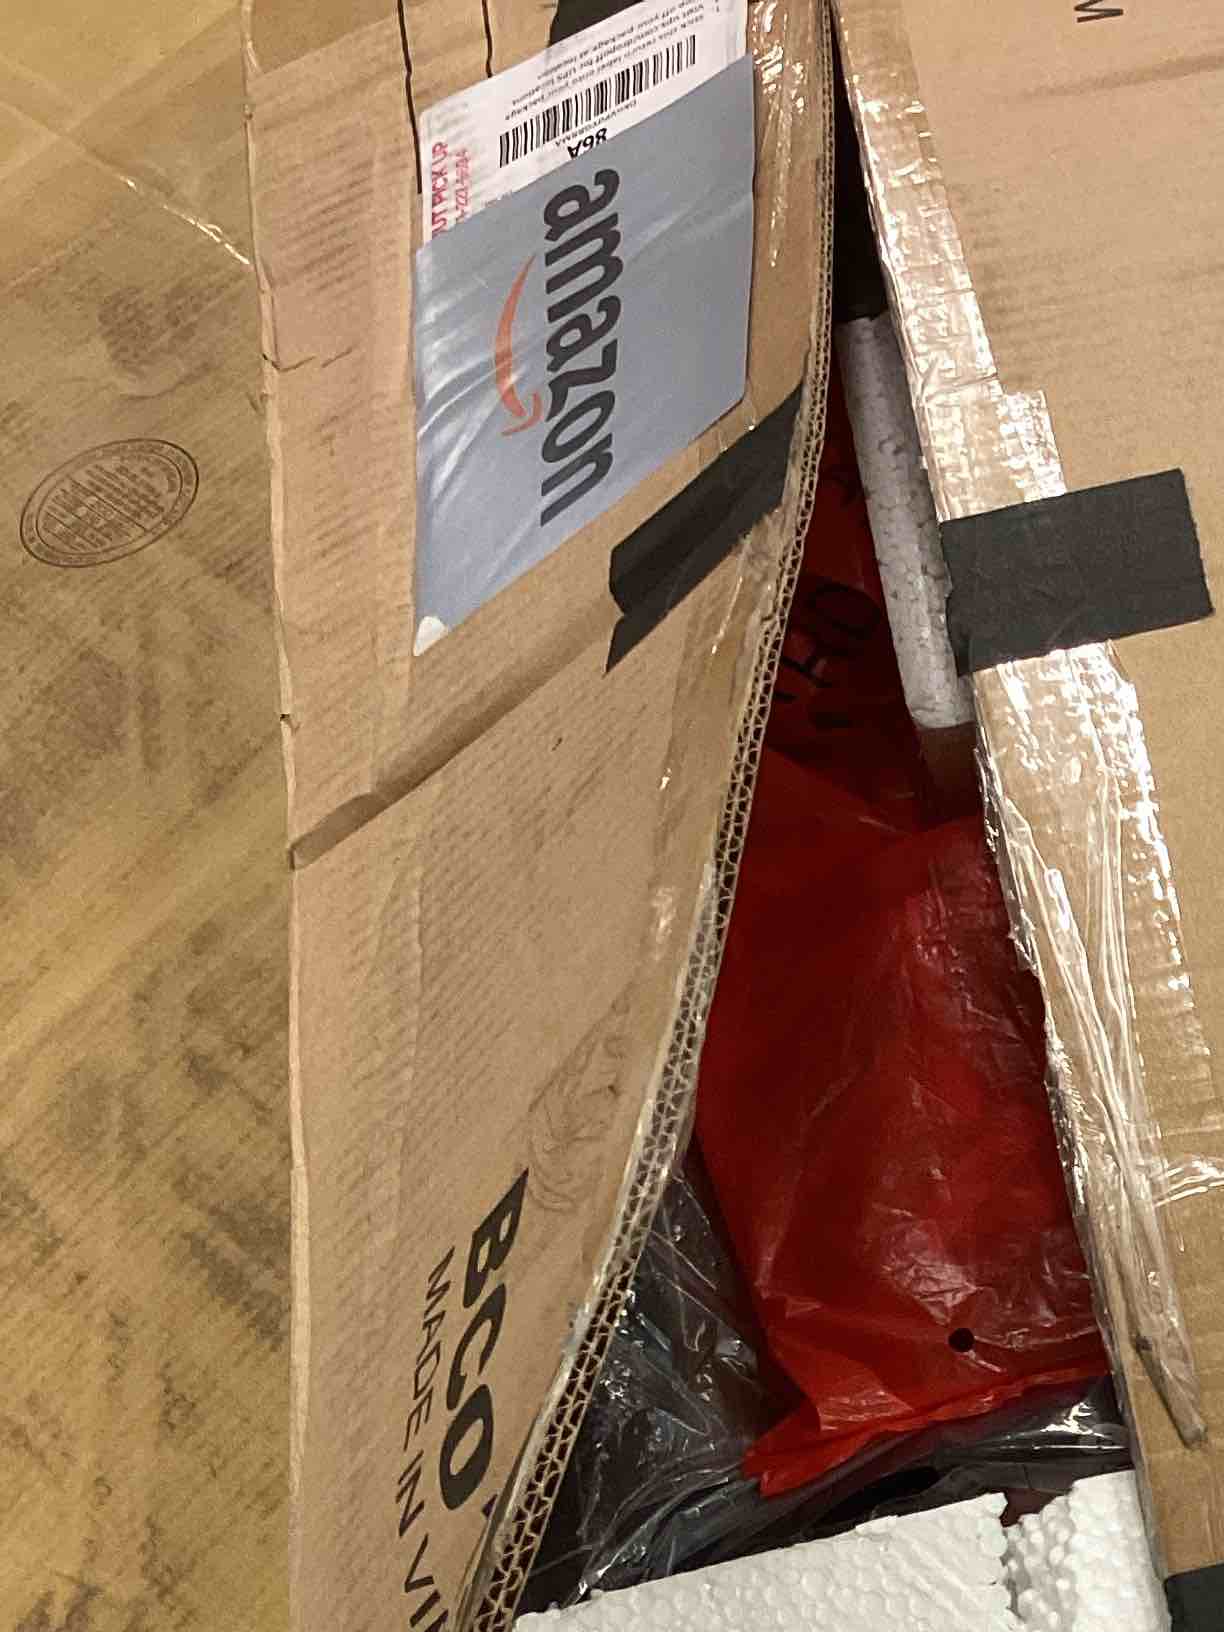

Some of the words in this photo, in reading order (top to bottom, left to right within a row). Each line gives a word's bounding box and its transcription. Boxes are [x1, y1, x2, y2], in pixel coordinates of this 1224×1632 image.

[540, 168, 623, 527] amazon
[403, 1245, 456, 1452] MADE
[395, 1449, 426, 1537] IN
